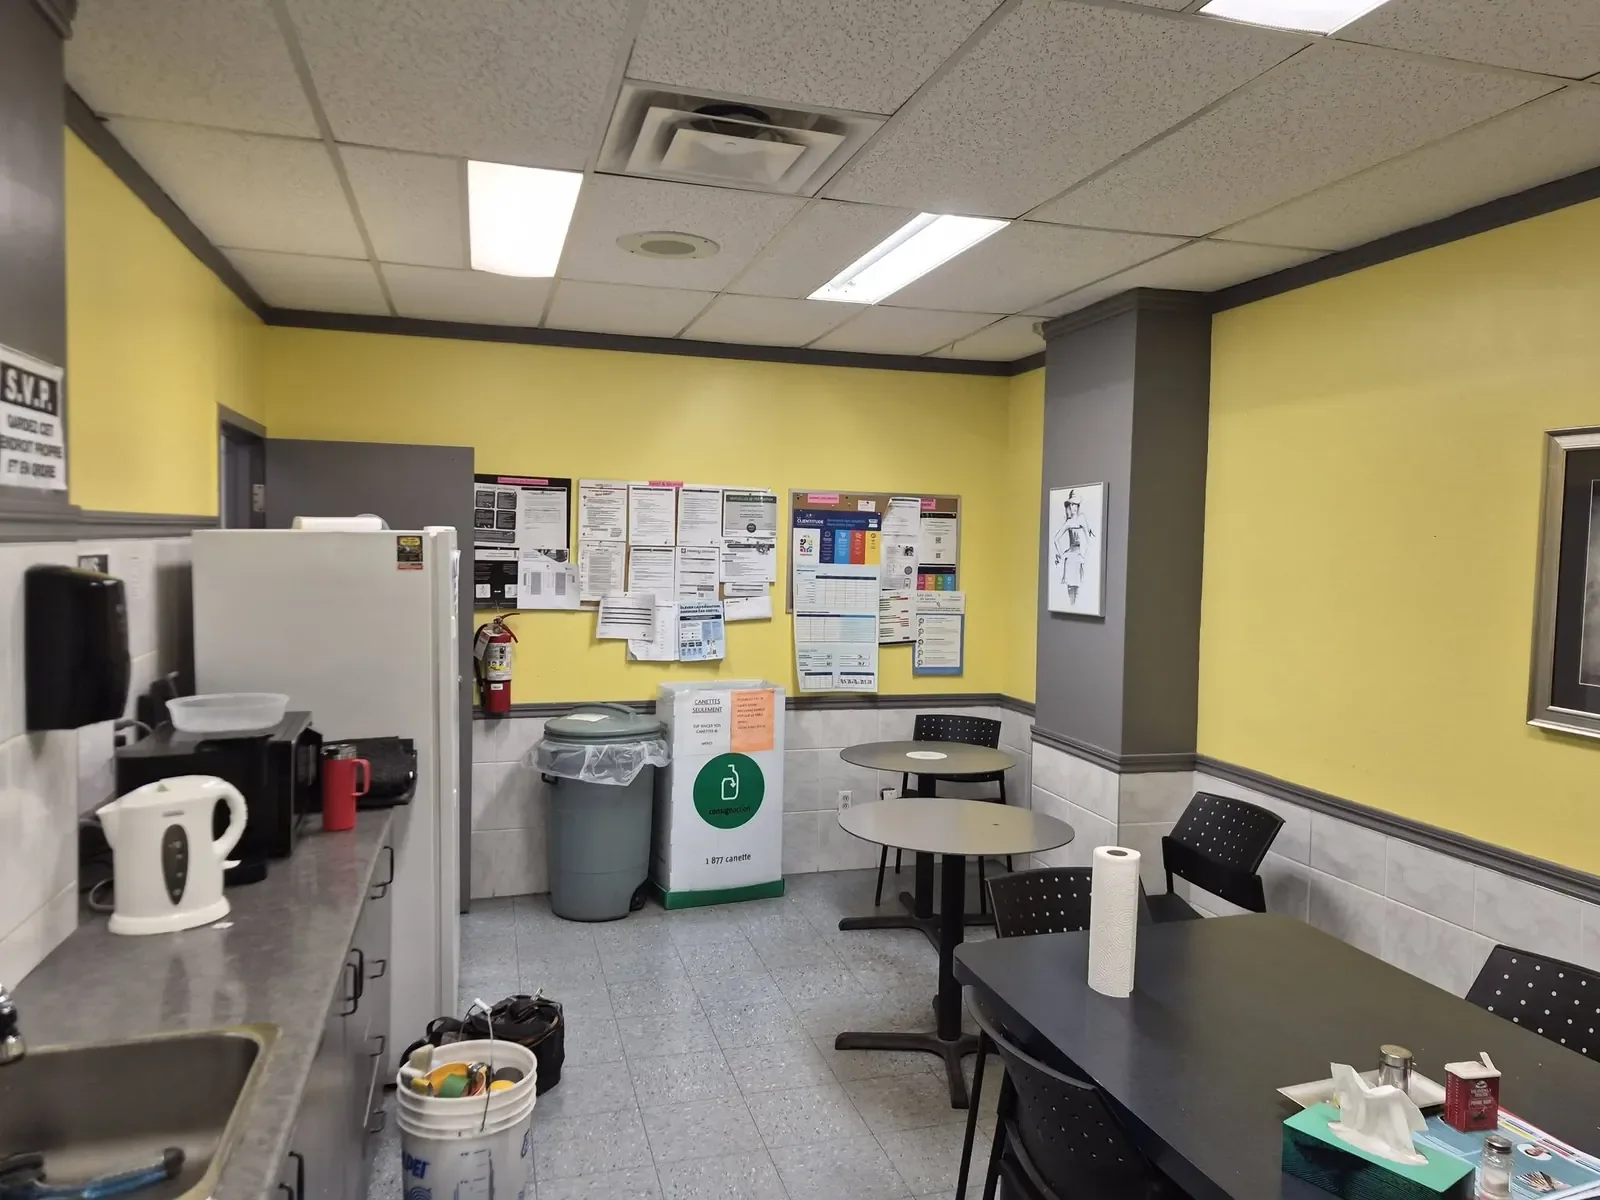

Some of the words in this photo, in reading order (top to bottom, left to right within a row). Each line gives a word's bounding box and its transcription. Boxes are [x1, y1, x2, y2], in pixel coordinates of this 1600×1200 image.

[5, 368, 53, 411] S.V.P.
[708, 806, 751, 815] consignaction
[711, 856, 723, 864] 877
[726, 854, 751, 862] canette
